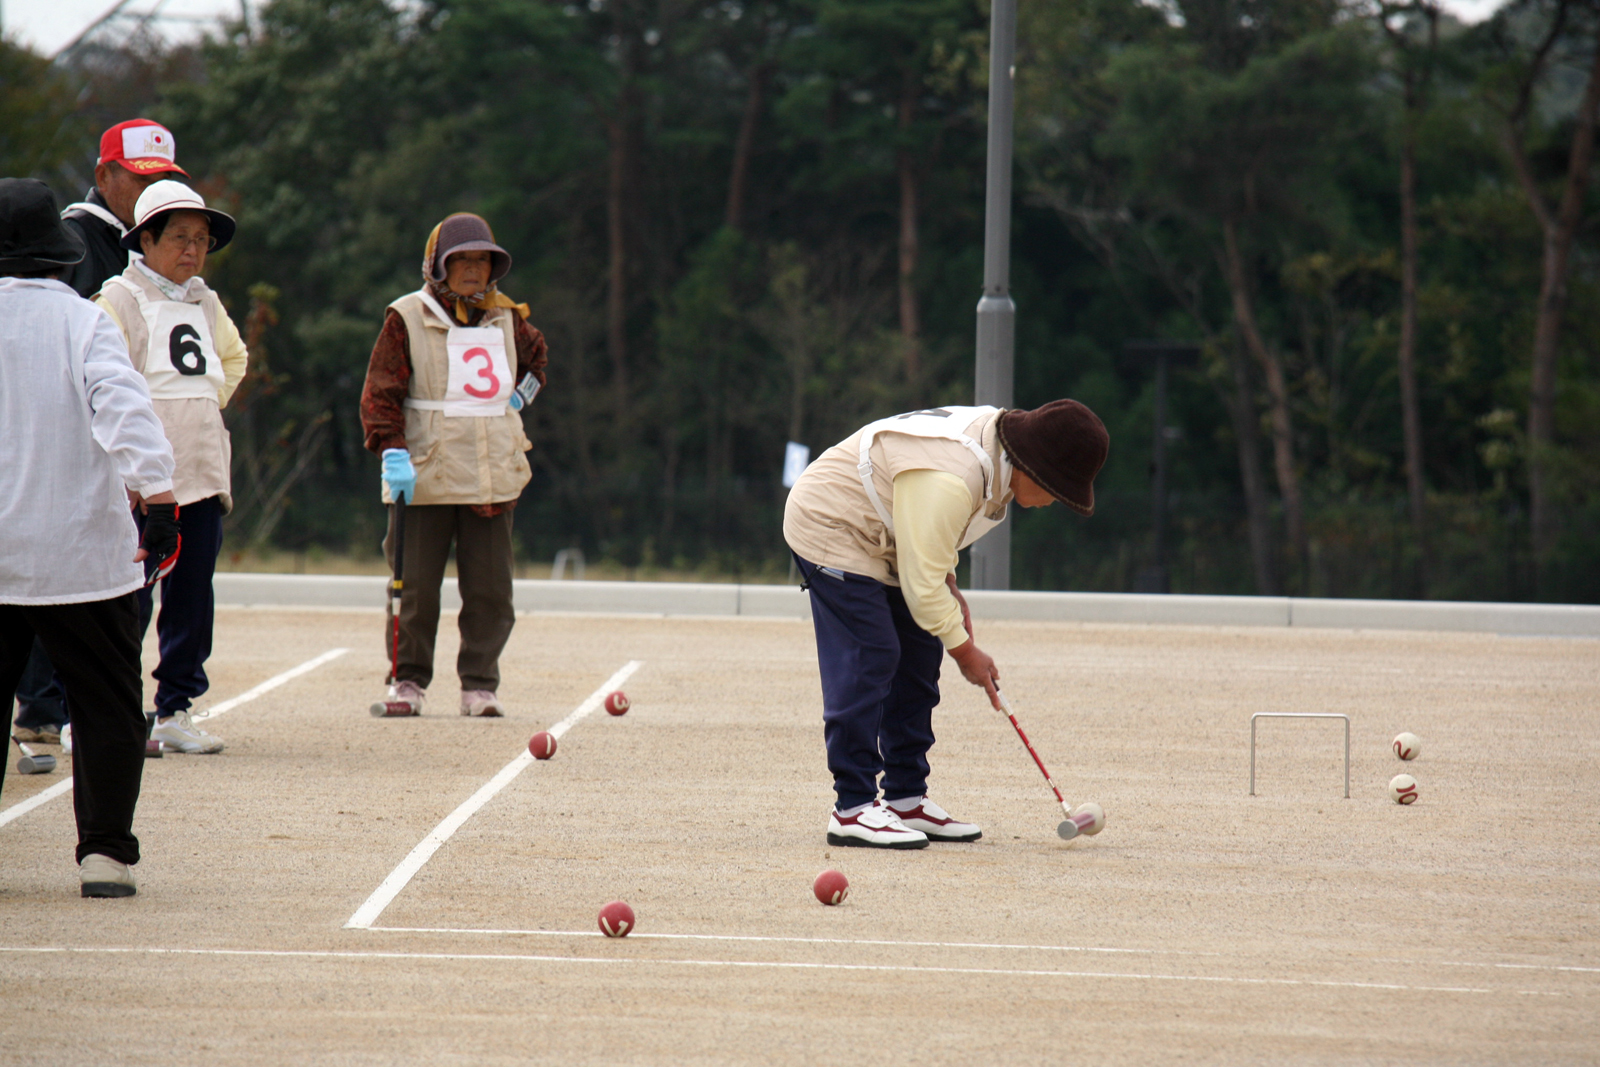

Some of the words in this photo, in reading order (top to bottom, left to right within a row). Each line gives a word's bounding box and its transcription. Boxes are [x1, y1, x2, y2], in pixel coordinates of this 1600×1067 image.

[169, 324, 206, 376] 6
[462, 347, 500, 399] 3
[546, 734, 552, 755] 1
[1396, 783, 1418, 805] 10
